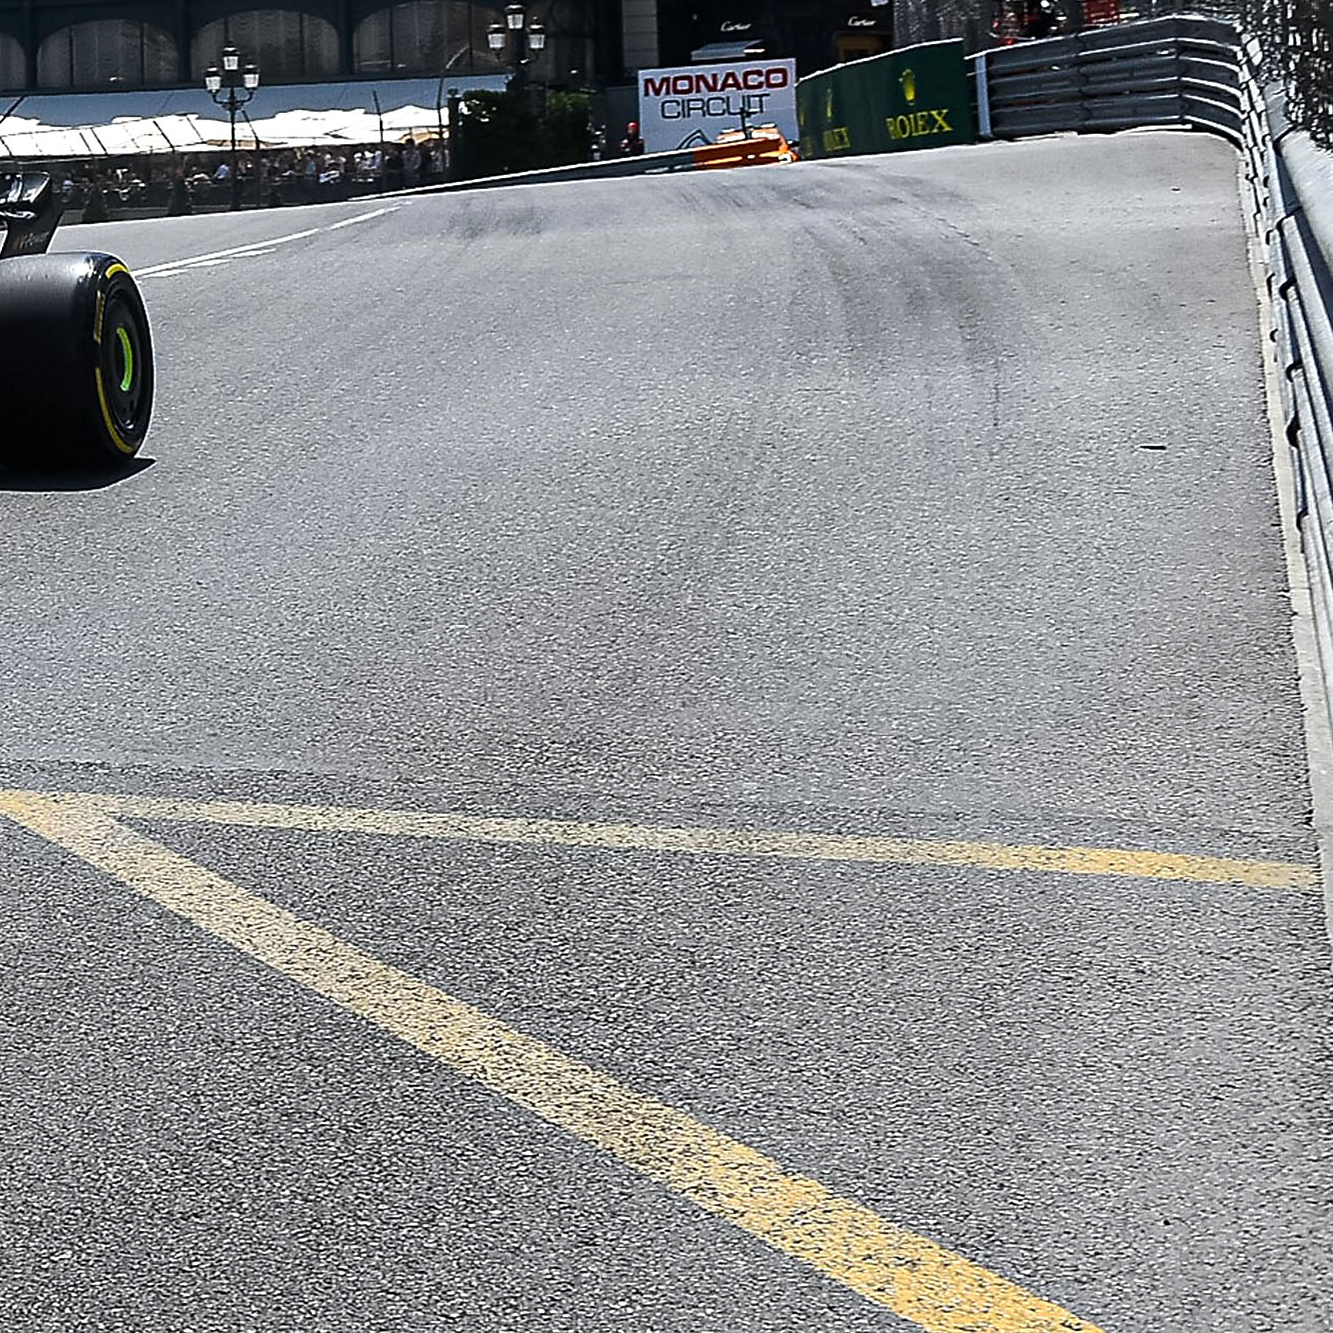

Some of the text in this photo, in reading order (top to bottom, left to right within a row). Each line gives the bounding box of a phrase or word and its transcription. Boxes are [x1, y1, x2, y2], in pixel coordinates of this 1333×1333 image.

[643, 67, 789, 97] MONACO
[661, 93, 771, 120] CIRCUIT
[885, 108, 954, 140] ROLEX
